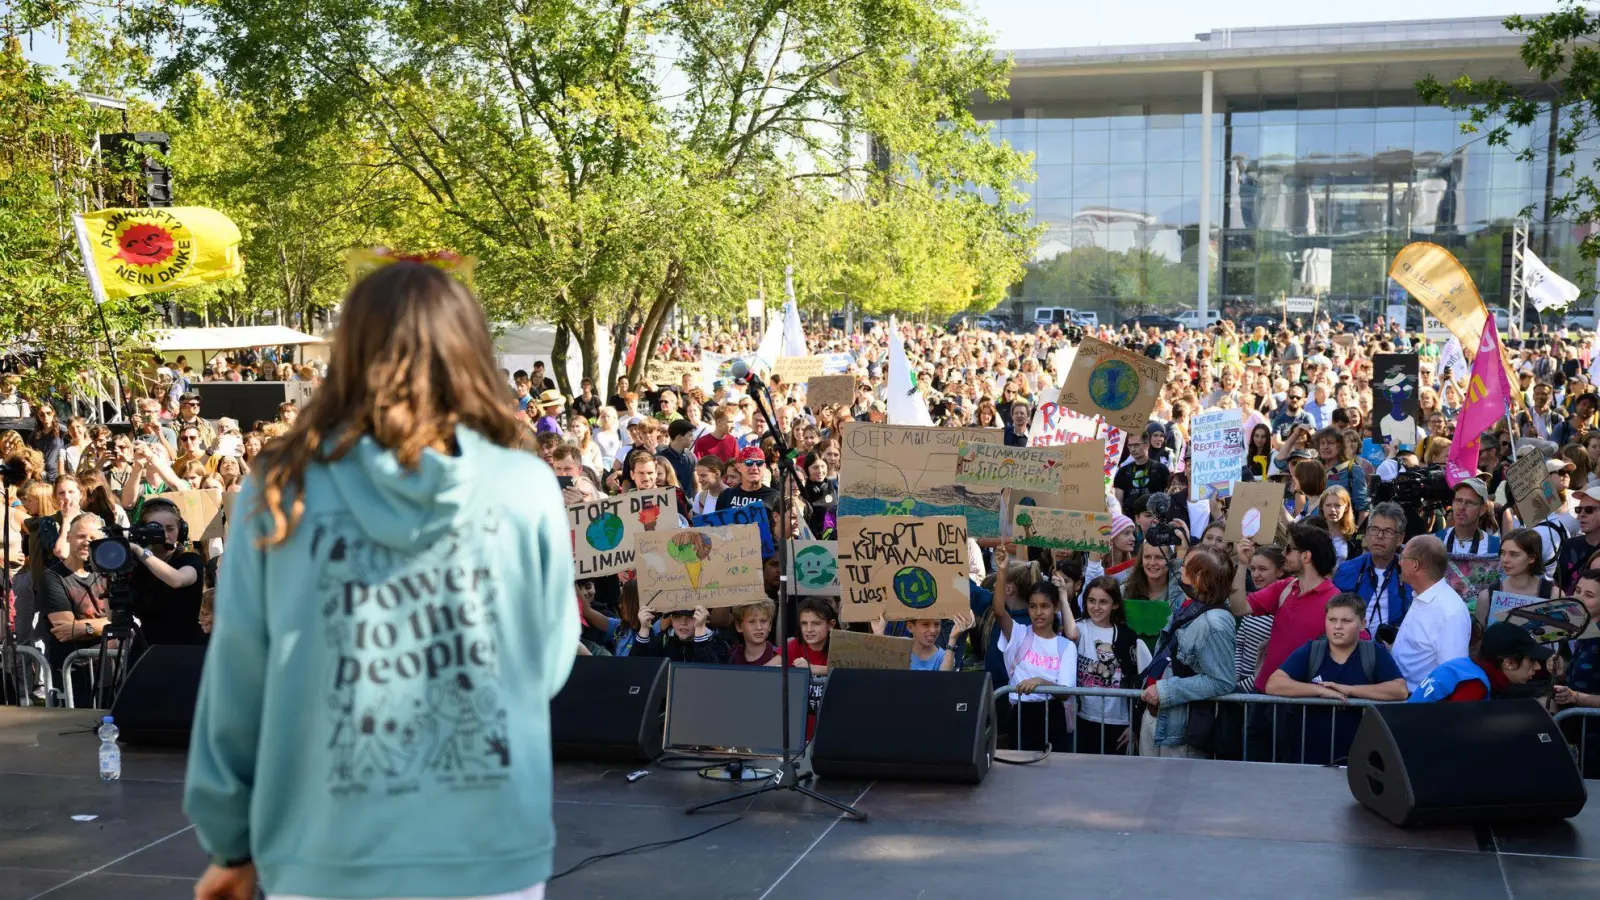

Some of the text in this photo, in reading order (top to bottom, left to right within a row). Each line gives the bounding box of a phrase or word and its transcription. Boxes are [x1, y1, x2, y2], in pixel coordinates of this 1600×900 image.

[115, 240, 191, 285] NEIN DANKE
[852, 430, 893, 447] DER
[565, 494, 669, 525] TOPT DEN
[859, 522, 967, 547] STOPT DEN
[573, 550, 636, 575] LIMAW
[846, 564, 873, 584] TUT
[355, 601, 479, 650] to the
[334, 632, 489, 692] people
